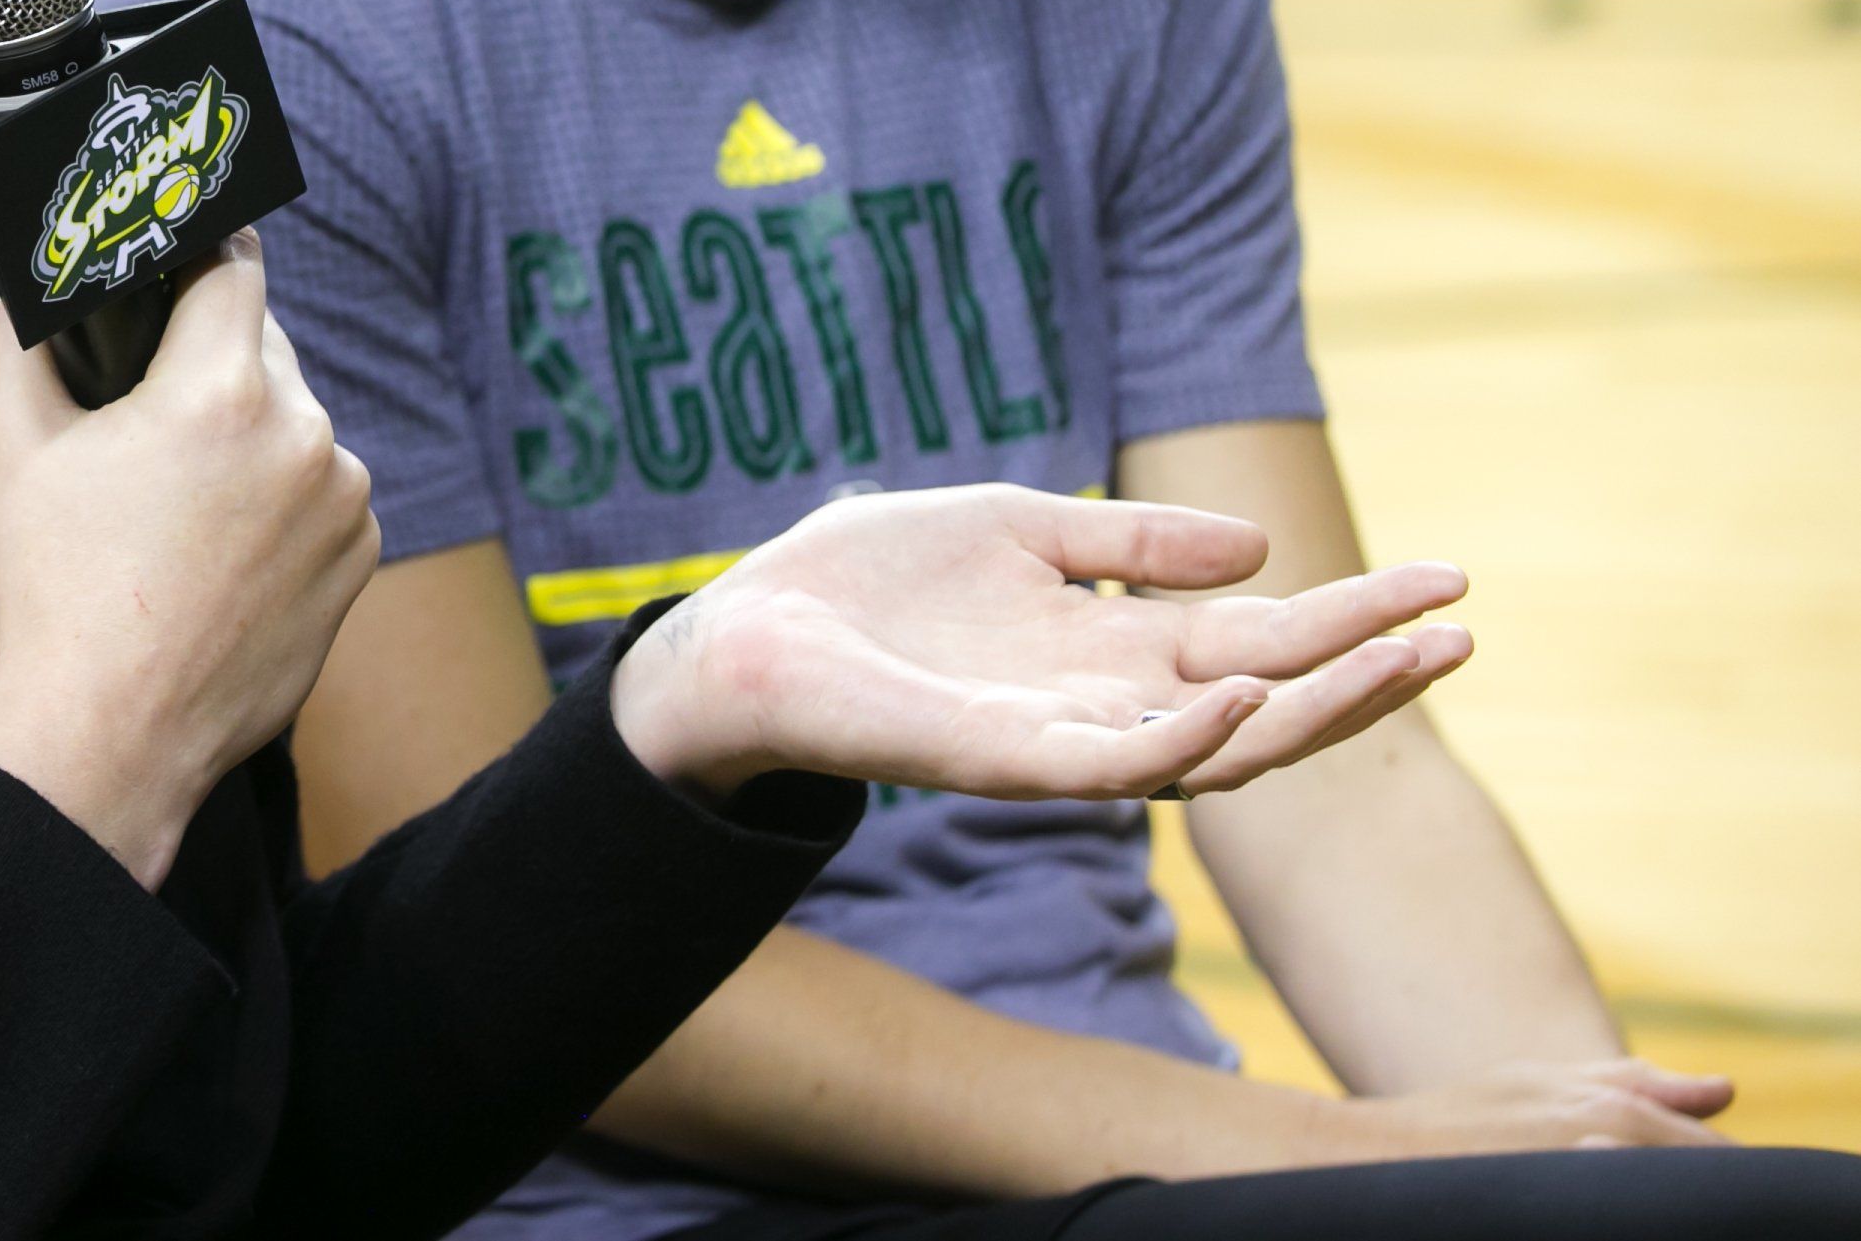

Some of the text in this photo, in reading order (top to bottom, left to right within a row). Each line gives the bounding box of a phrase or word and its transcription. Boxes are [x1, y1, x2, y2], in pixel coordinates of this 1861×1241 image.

[21, 70, 59, 91] SM58
[51, 75, 213, 295] STORM
[95, 116, 160, 196] SEATTLE
